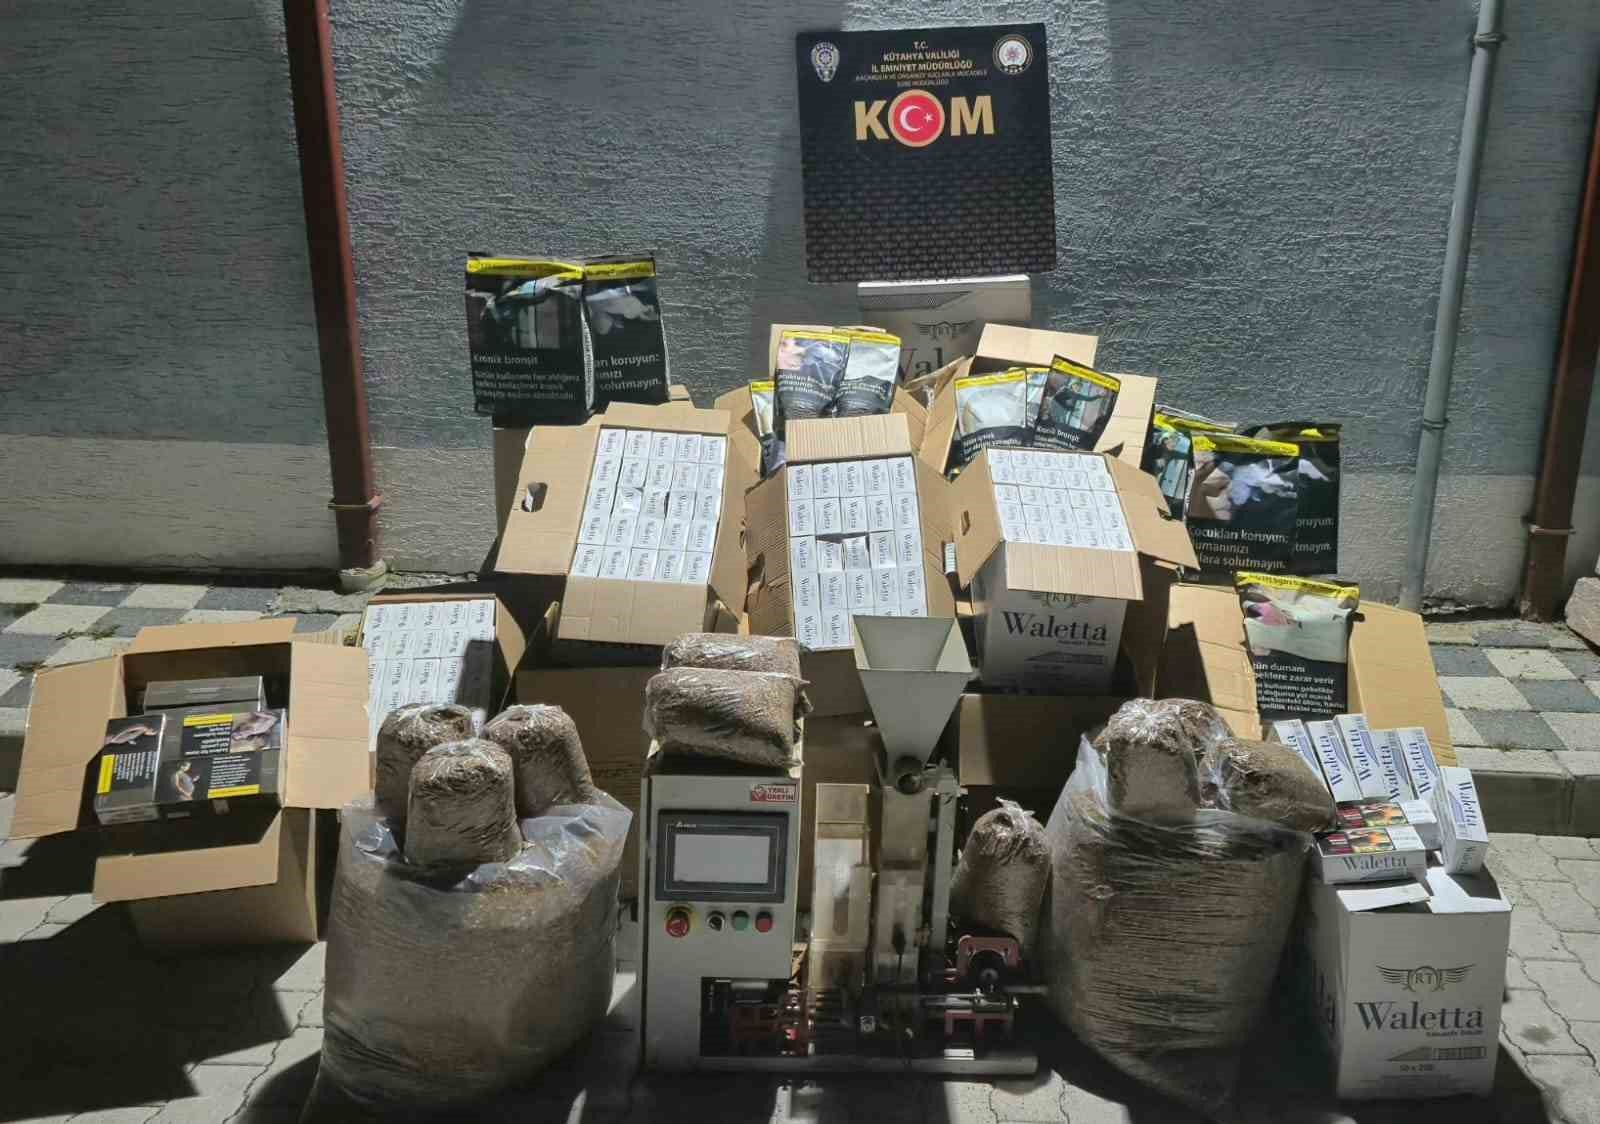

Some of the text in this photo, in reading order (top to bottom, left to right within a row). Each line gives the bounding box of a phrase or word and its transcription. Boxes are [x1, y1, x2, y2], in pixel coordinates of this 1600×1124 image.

[1000, 611, 1107, 641] Waletta
[1320, 735, 1343, 786] Waletta
[1350, 728, 1373, 781] Waletta
[1409, 742, 1431, 794] Waletta
[1458, 782, 1478, 827] Waletta
[1343, 855, 1407, 870] Waletta
[1353, 1001, 1484, 1031] Waletta
